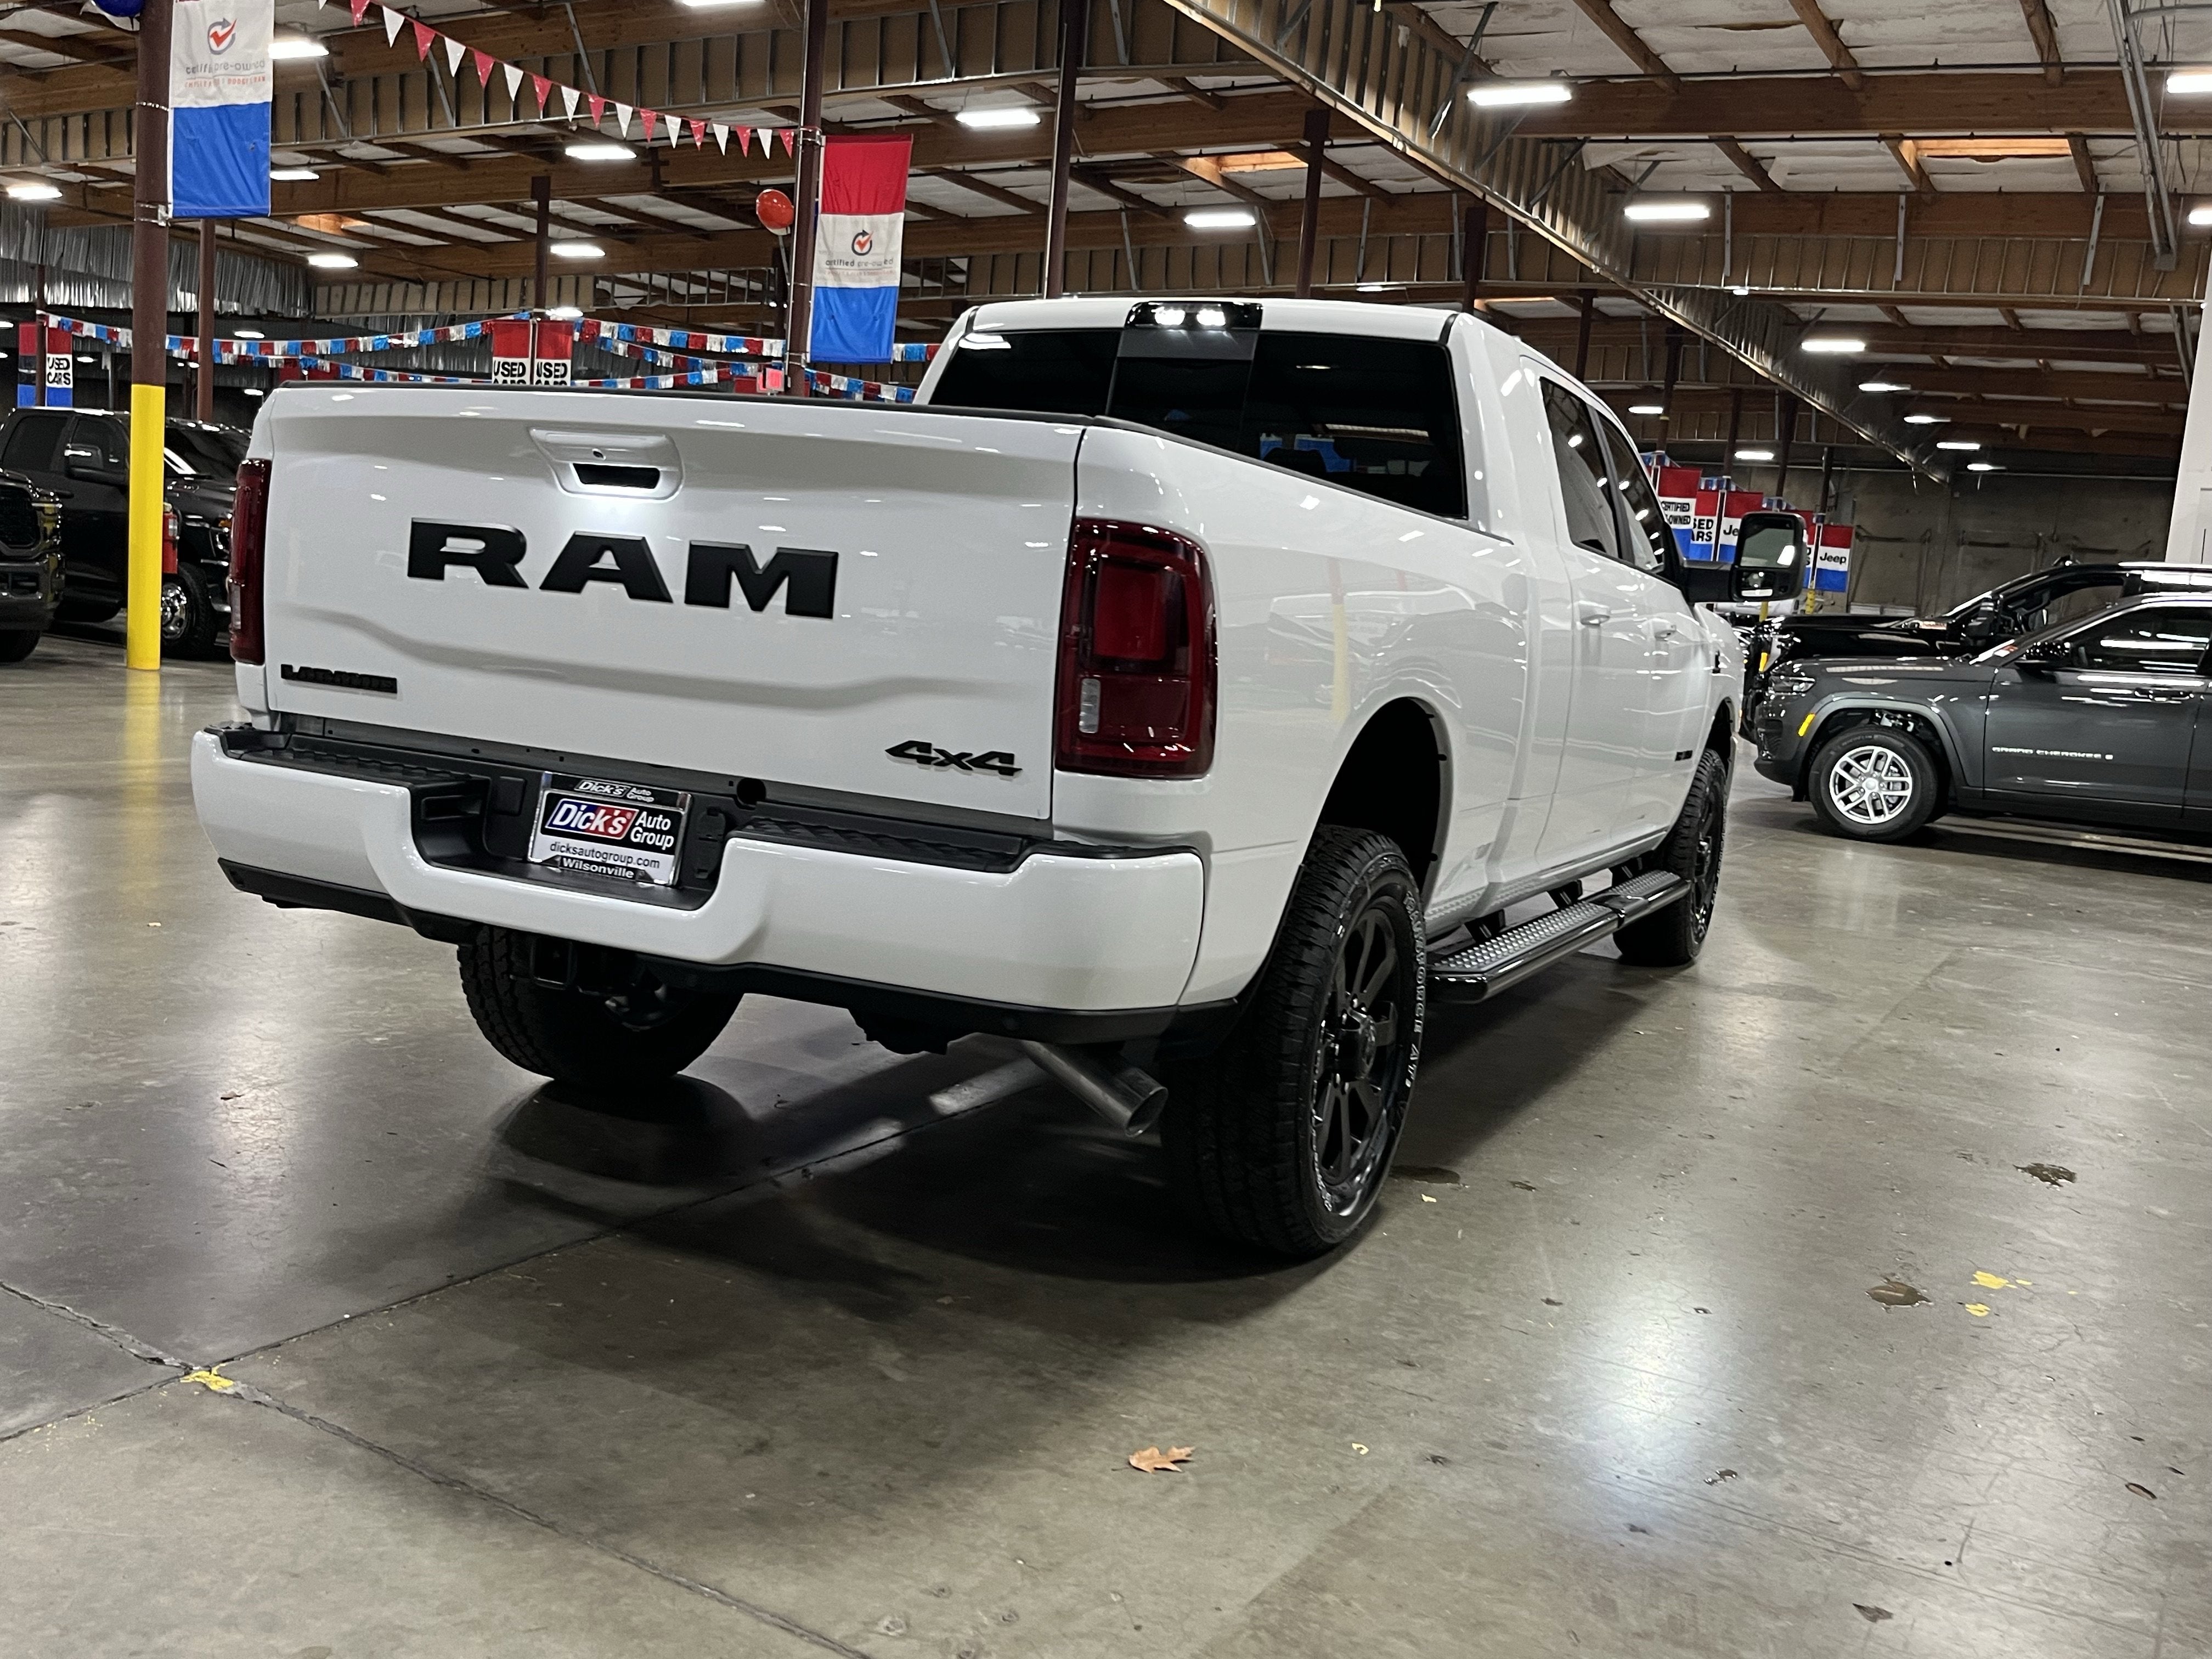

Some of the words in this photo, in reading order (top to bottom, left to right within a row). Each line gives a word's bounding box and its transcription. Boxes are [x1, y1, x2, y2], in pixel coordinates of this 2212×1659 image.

[47, 357, 70, 370] USED
[494, 360, 526, 377] USED
[536, 362, 568, 379] USED
[1693, 518, 1714, 529] SED
[1723, 524, 1739, 536] Je
[1819, 552, 1847, 565] Jeep
[408, 517, 839, 619] RAM
[579, 781, 624, 795] Dick's
[552, 804, 627, 834] Dick's
[635, 811, 672, 831] Auto
[630, 826, 675, 850] Group
[550, 842, 661, 868] dicksautogroup.com
[562, 857, 635, 878] Wilsonville
